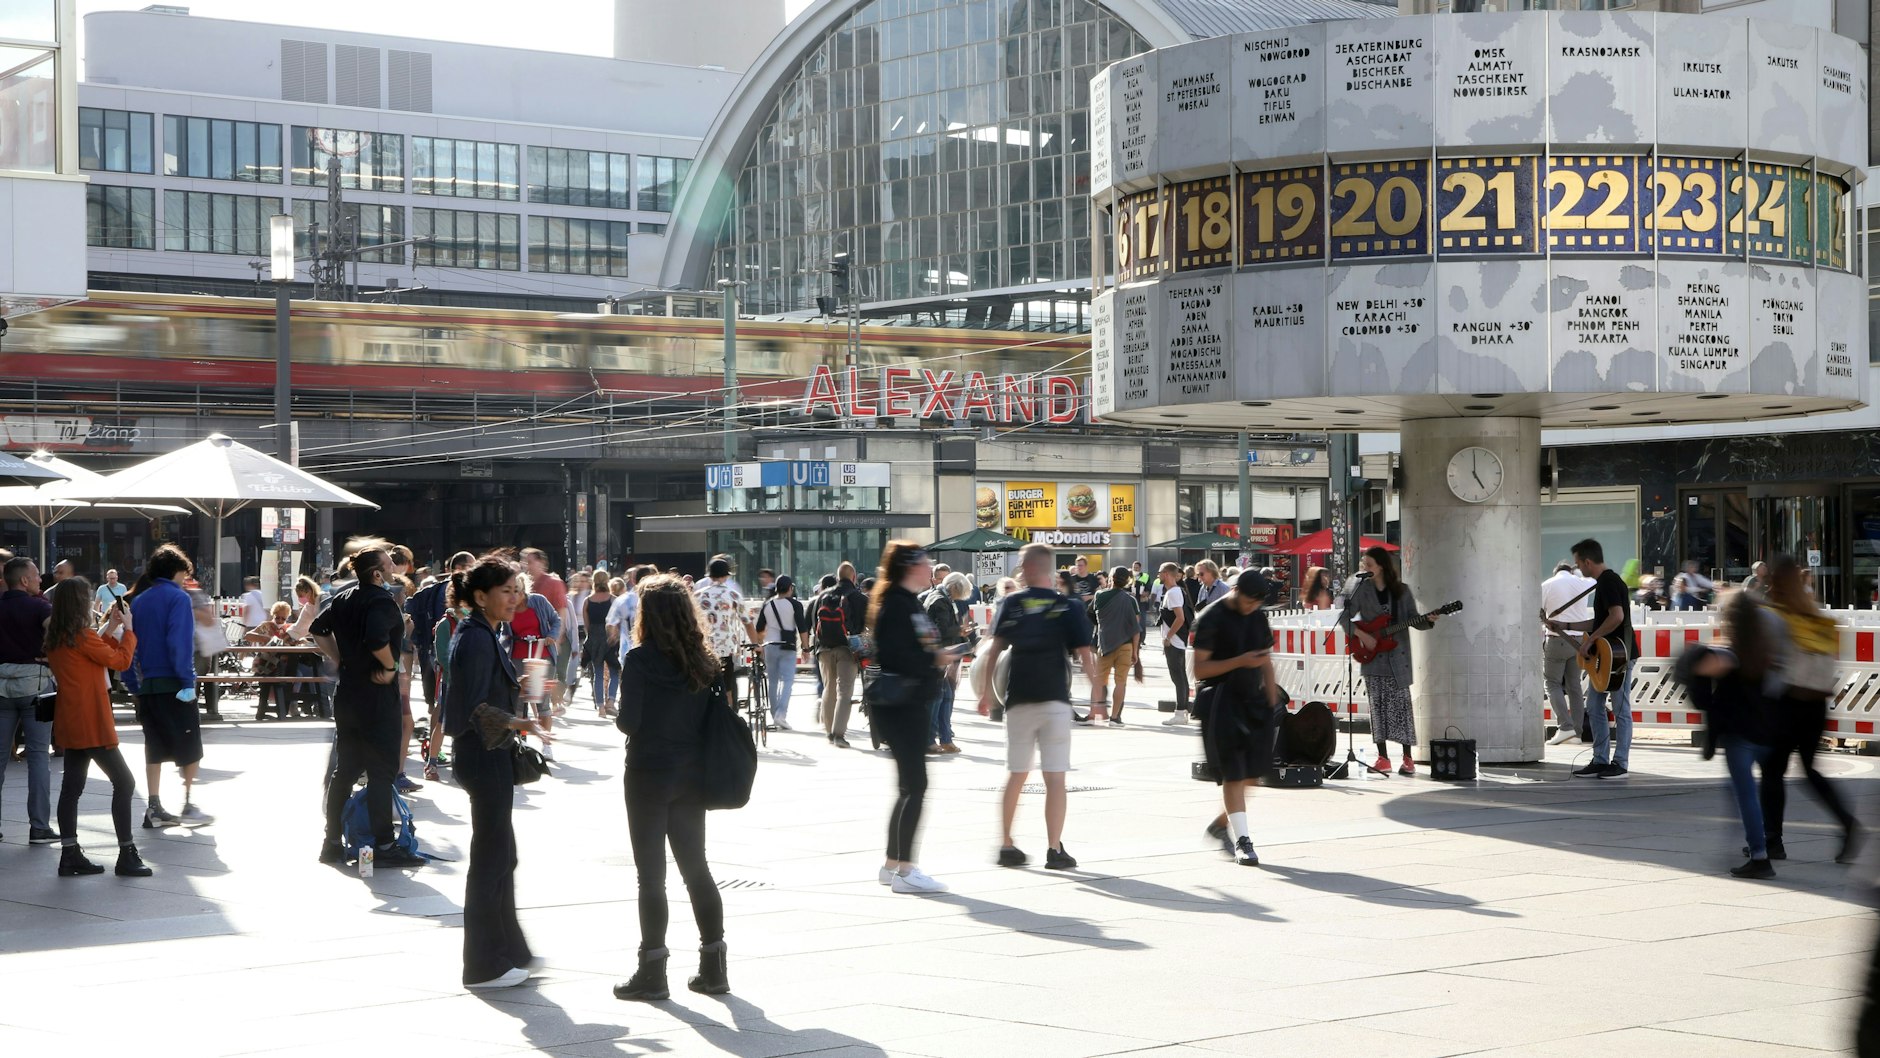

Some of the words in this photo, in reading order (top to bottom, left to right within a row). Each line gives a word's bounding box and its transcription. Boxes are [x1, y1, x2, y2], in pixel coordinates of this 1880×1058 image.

[1244, 37, 1289, 52] NISCHNIJ
[1335, 38, 1423, 54] JEKATERINBURG
[1260, 47, 1310, 63] NOWGOROD
[1474, 48, 1506, 58] OMSK
[1562, 47, 1641, 57] KRASNOJARSK
[1345, 51, 1412, 66] ASCHGABAT
[1767, 56, 1799, 70] JAKUTSK
[1352, 64, 1404, 78] BISCHKEK
[1468, 61, 1513, 71] ALMATY
[1682, 62, 1722, 74] IRKUTSK
[1127, 80, 1139, 89] RIGA
[1172, 72, 1215, 89] MURMANSK
[1248, 72, 1307, 89] WOLGOGRAD
[1346, 76, 1413, 91] DUSCHANBE
[1457, 73, 1524, 85] TASCHKENT
[1124, 90, 1144, 102] TALLINN
[1177, 83, 1221, 100] PETERSBURG
[1264, 86, 1290, 99] BAKU
[1453, 86, 1528, 98] NOWOSIBIRSK
[1673, 87, 1731, 100] ULAN-BATOR
[1178, 98, 1209, 112] MOSKAU
[1263, 98, 1291, 112] TIFLIS
[1259, 111, 1295, 125] ERIWAN
[1440, 171, 1516, 232] 21
[1541, 170, 1630, 230] 22
[1644, 171, 1718, 232] 23
[1729, 175, 1786, 237] 24
[1332, 176, 1423, 237] 20
[1251, 183, 1316, 243] 19
[1182, 191, 1231, 252] 18
[1135, 200, 1168, 260] 17
[1169, 287, 1204, 299] TEHERAN
[1687, 283, 1720, 294] PEKING
[1125, 294, 1146, 306] ANKARA
[1181, 298, 1211, 310] BAGDAD
[1336, 300, 1358, 311] NEW
[1366, 299, 1398, 310] DELHI
[1586, 295, 1621, 305] HANOI
[1677, 295, 1729, 307] SHANGHAI
[1124, 306, 1147, 318] ISTANBUL
[1185, 311, 1207, 321] ADEN
[1252, 305, 1283, 316] KABUL
[1578, 308, 1628, 317] BANGKOK
[1685, 308, 1723, 319] MANILA
[1254, 315, 1305, 328] MAURITIUS
[1354, 311, 1407, 323] KARACHI
[1772, 312, 1793, 323] TOKYO
[1128, 318, 1144, 329] ATHEN
[1182, 323, 1210, 334] SANAA
[1453, 321, 1502, 333] RANGUN
[1567, 321, 1606, 331] PHNOM
[1612, 321, 1640, 330] PENH
[1689, 322, 1718, 332] PERTH
[1772, 324, 1794, 335] SEOUL
[1342, 324, 1391, 336] COLOMBO
[1170, 336, 1193, 347] ADDIS
[1196, 334, 1222, 344] ABEBA
[1471, 334, 1514, 345] DHAKA
[1578, 333, 1629, 343] JAKARTA
[1678, 333, 1730, 345] HONGKONG
[1123, 341, 1149, 354] JERUSALEM
[1170, 346, 1221, 359] MOGADISCHU
[1668, 346, 1699, 357] KUALA
[1703, 346, 1740, 358] LUMPUR
[1128, 354, 1144, 365] BEIRUT
[1170, 359, 1221, 371] DARESSALAM
[1680, 359, 1727, 370] SINGAPUR
[1129, 377, 1143, 388] KAIRO
[1166, 370, 1227, 384] ANTANANARIVO
[804, 364, 1099, 424] ALEXAND
[1182, 384, 1210, 394] KUWAIT
[792, 462, 808, 485] U
[844, 464, 855, 473] U8
[708, 467, 718, 488] U
[843, 475, 855, 484] U5
[1008, 489, 1043, 500] BURGER
[1025, 499, 1054, 508] MITTE?
[1112, 497, 1124, 505] ICH
[1009, 509, 1035, 519] BITTE!
[1112, 504, 1132, 512] LIEBE
[828, 516, 835, 524] U
[1113, 513, 1125, 521] ES!
[1033, 530, 1111, 545] McDonald's
